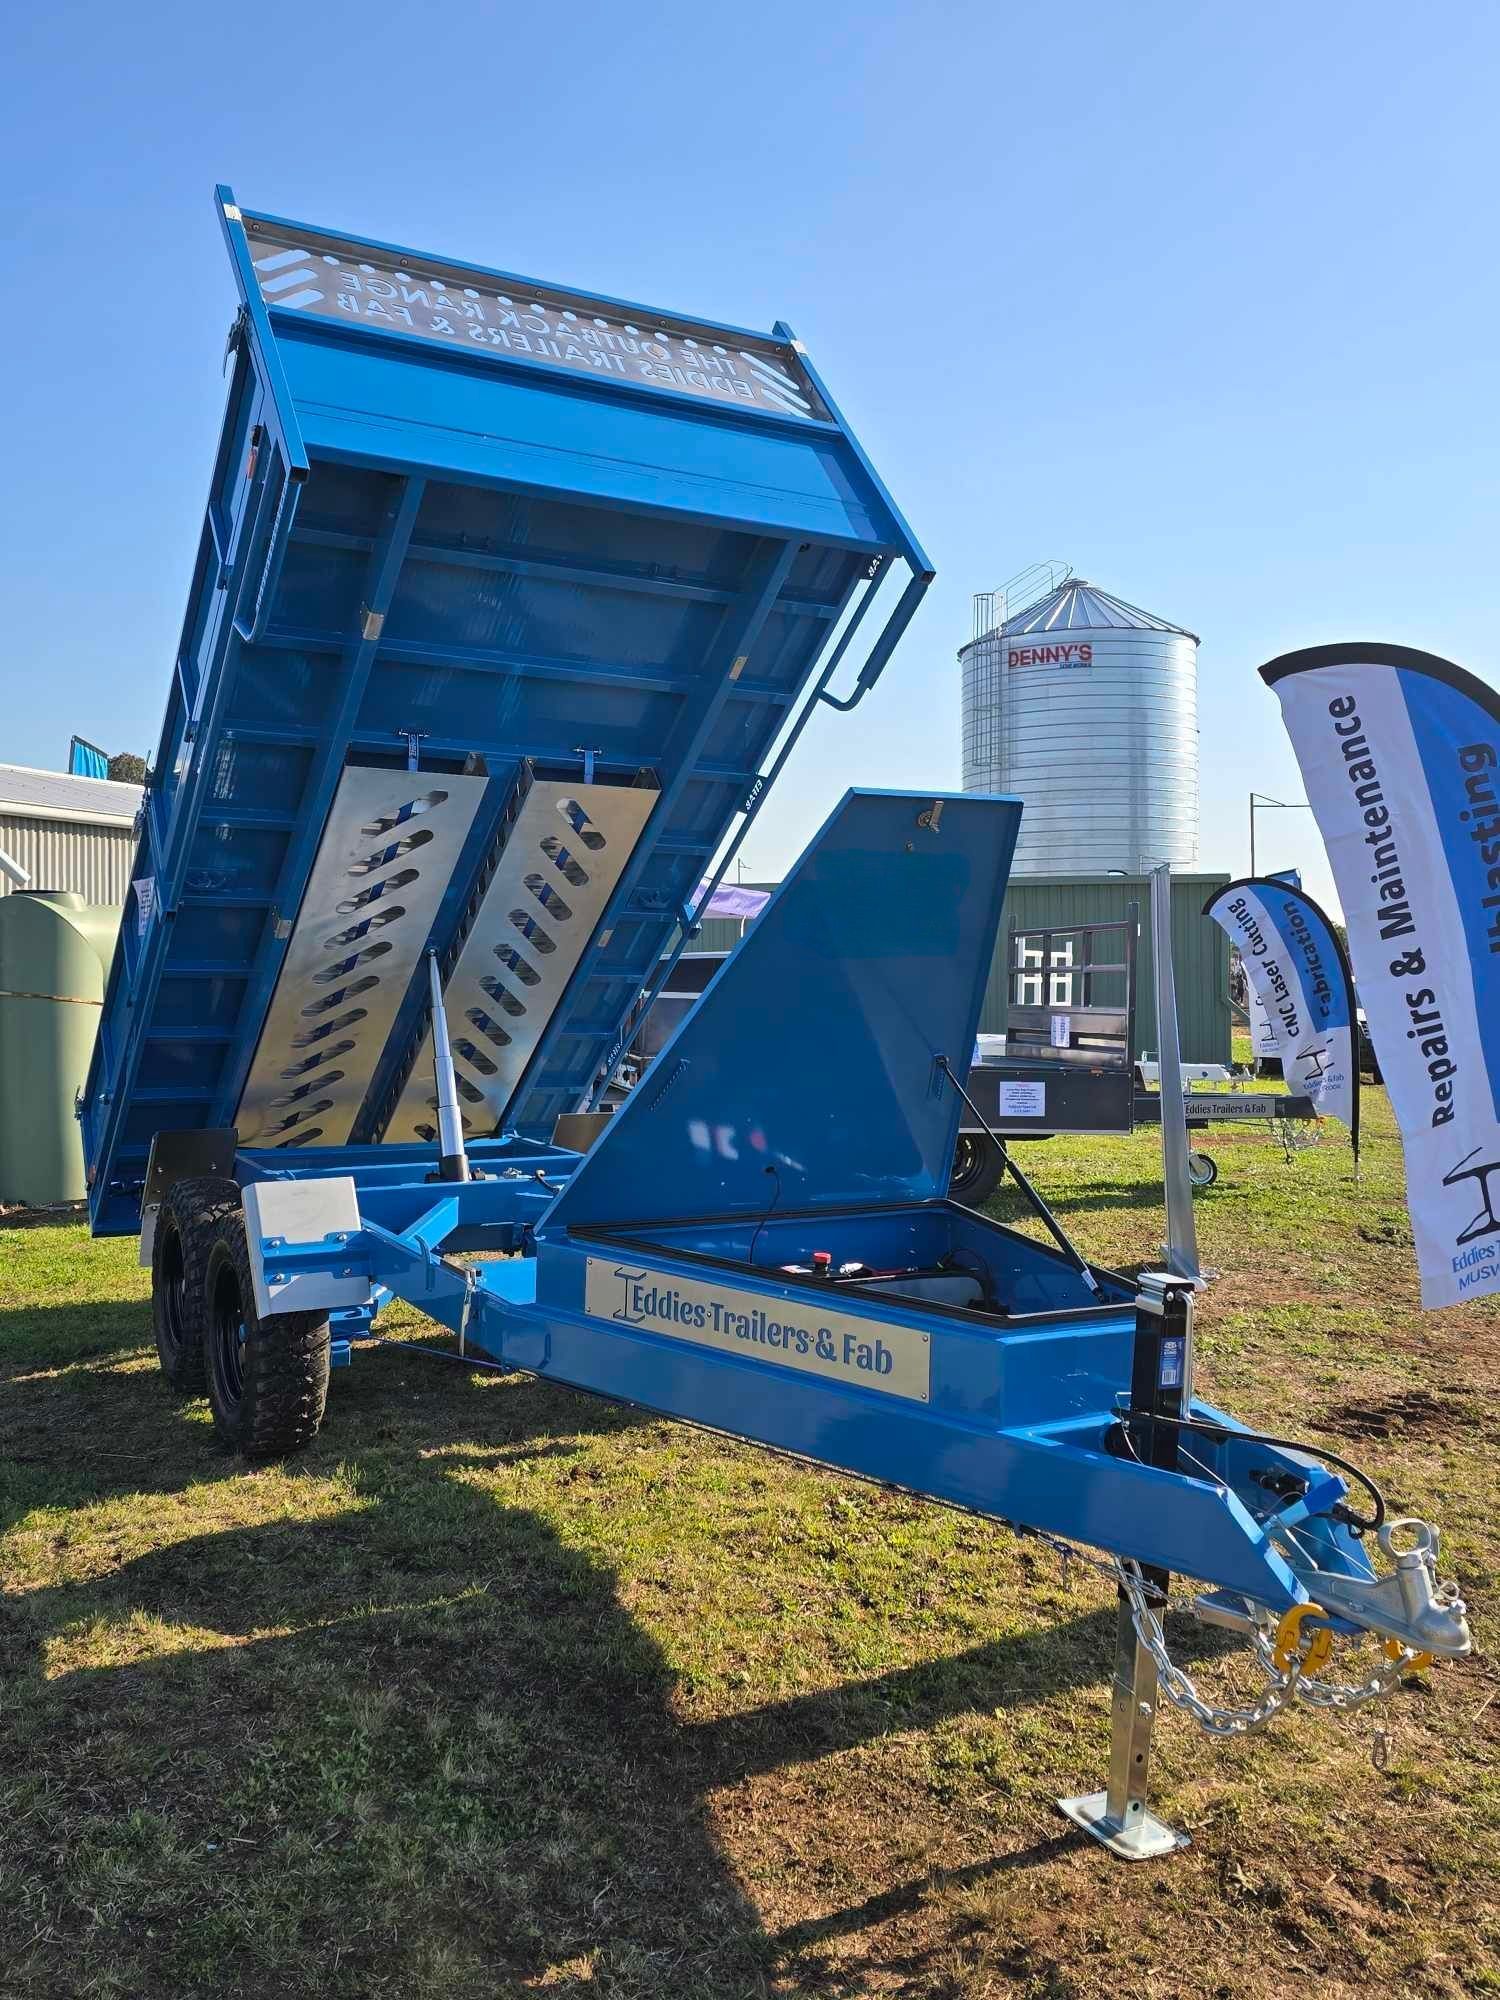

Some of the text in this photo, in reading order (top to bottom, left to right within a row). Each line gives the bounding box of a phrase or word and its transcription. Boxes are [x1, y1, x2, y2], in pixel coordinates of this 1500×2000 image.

[1008, 644, 1092, 668] DENNY'S
[1328, 695, 1457, 1128] Repairs & Maintenance
[1227, 898, 1300, 1038] CNC Laser Cutting
[1185, 1103, 1267, 1115] Eddies Trailers & Fab
[1452, 1245, 1495, 1272] Eddies
[633, 1285, 893, 1375] Eddies Trailers & Fab
